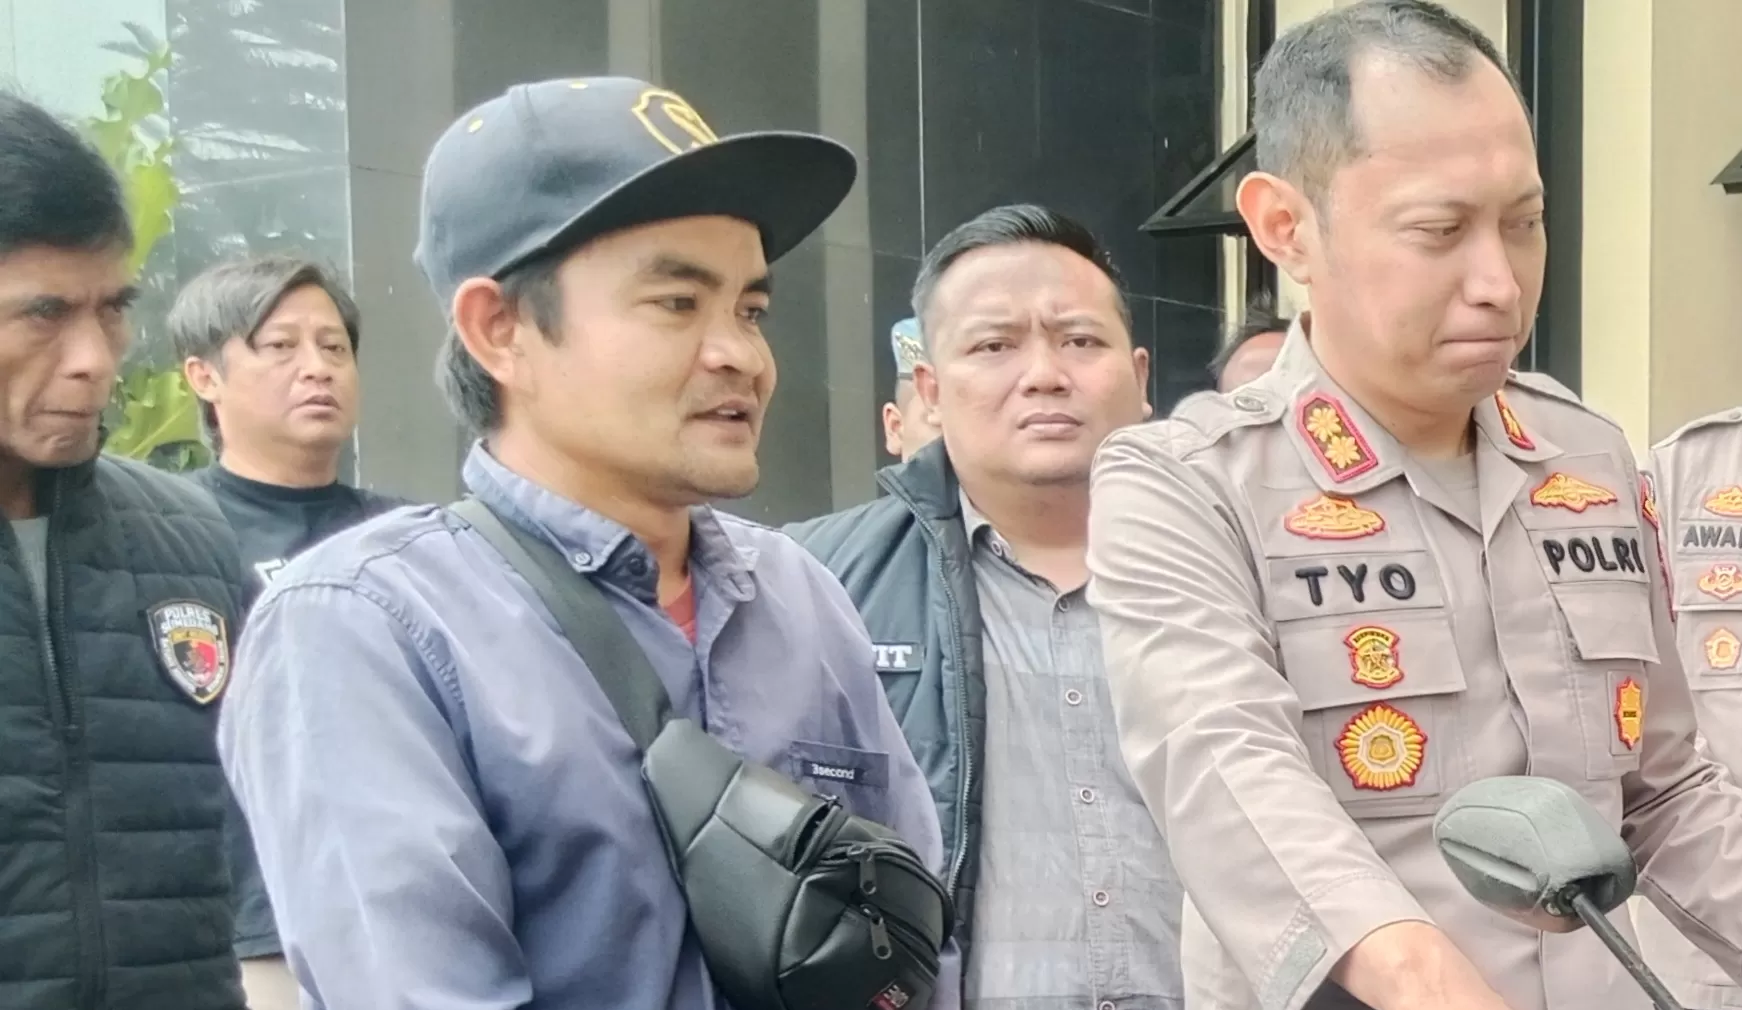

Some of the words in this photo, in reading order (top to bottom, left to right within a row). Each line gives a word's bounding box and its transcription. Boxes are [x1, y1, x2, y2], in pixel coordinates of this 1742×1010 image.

[1542, 536, 1645, 575] POLRI
[1295, 562, 1416, 607] TYO
[811, 763, 855, 780] 3second
